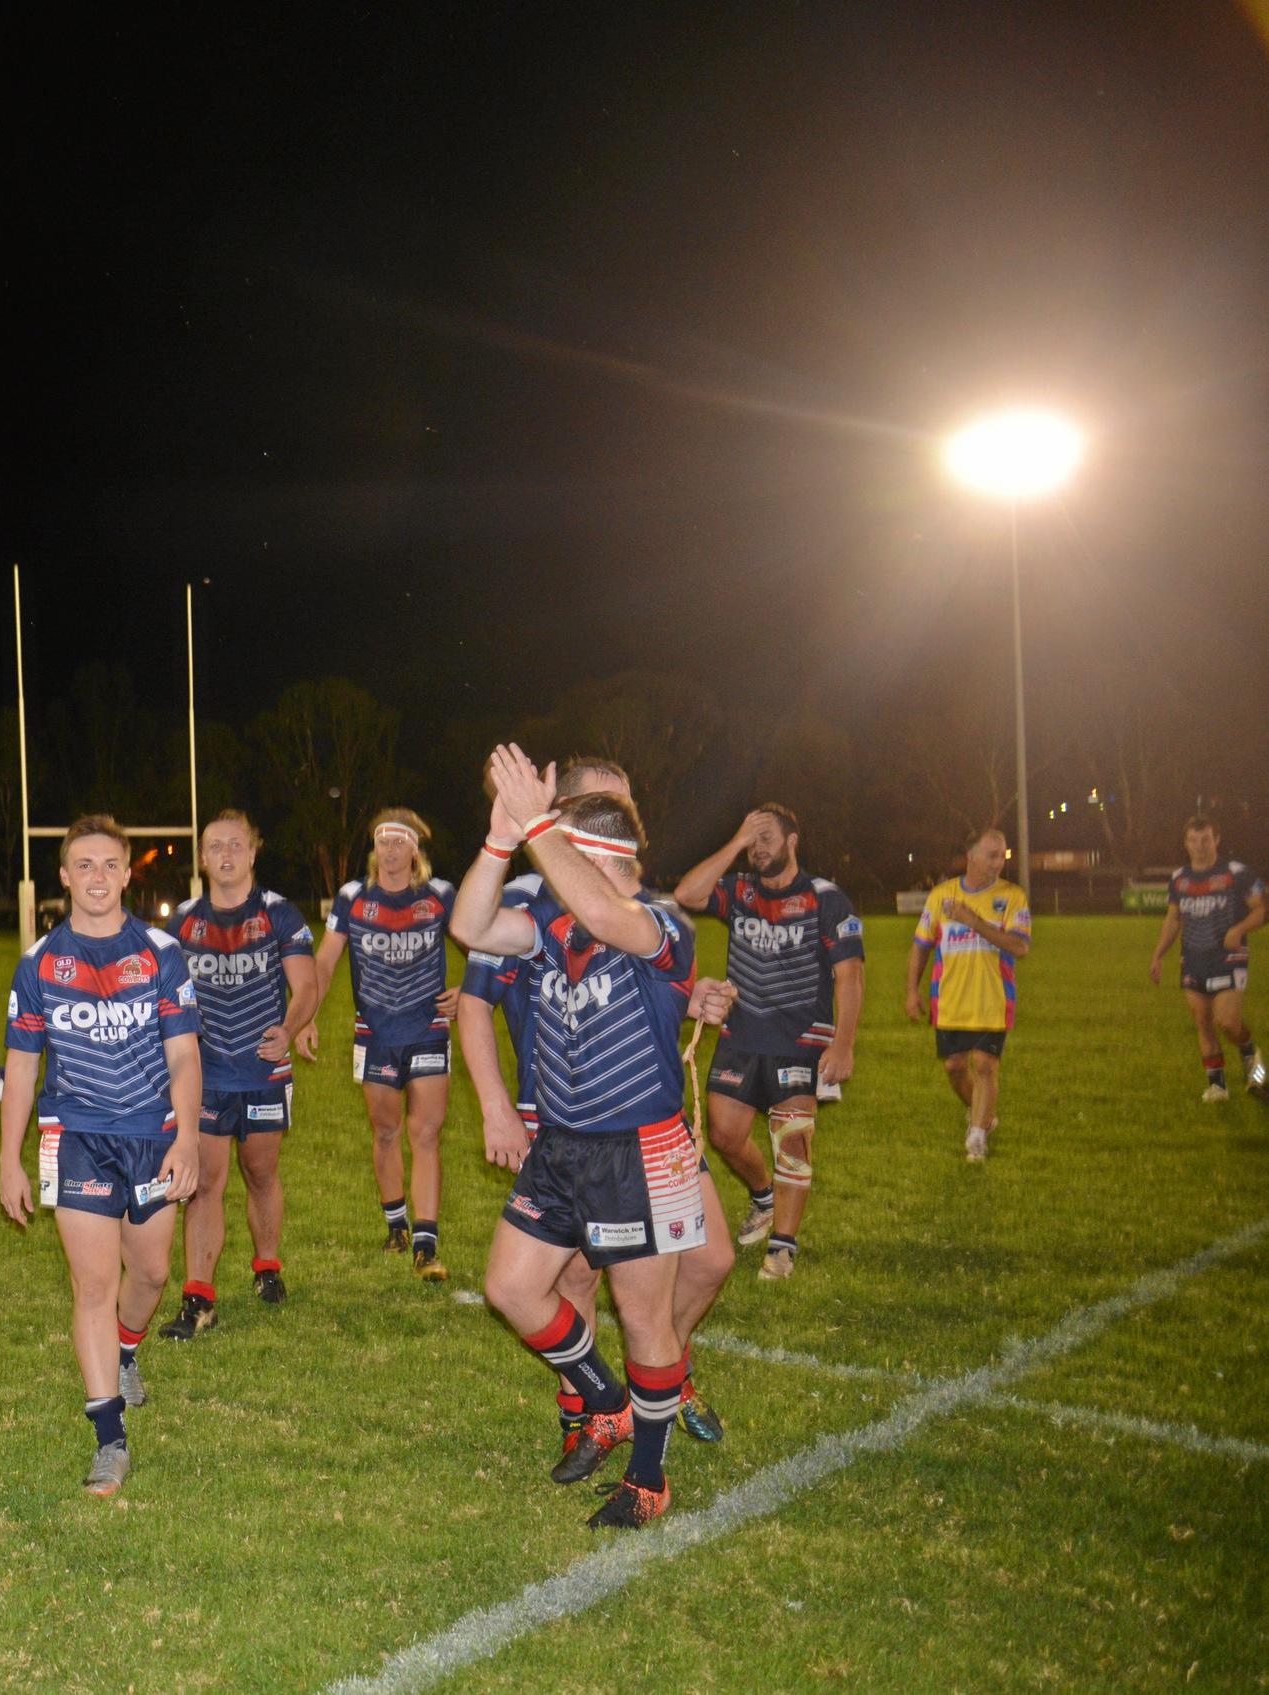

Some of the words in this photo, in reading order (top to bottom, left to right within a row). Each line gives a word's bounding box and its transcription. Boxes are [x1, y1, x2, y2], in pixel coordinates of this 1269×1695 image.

[362, 931, 436, 954] CONDY
[734, 916, 805, 946] CONDY
[384, 950, 414, 962] CLUB
[751, 937, 780, 953] CLUB
[188, 952, 269, 976] CONDY
[211, 974, 244, 985] CLUB
[541, 969, 613, 1013] CODY
[52, 1000, 153, 1031] CONDY
[89, 1026, 129, 1042] CLUB
